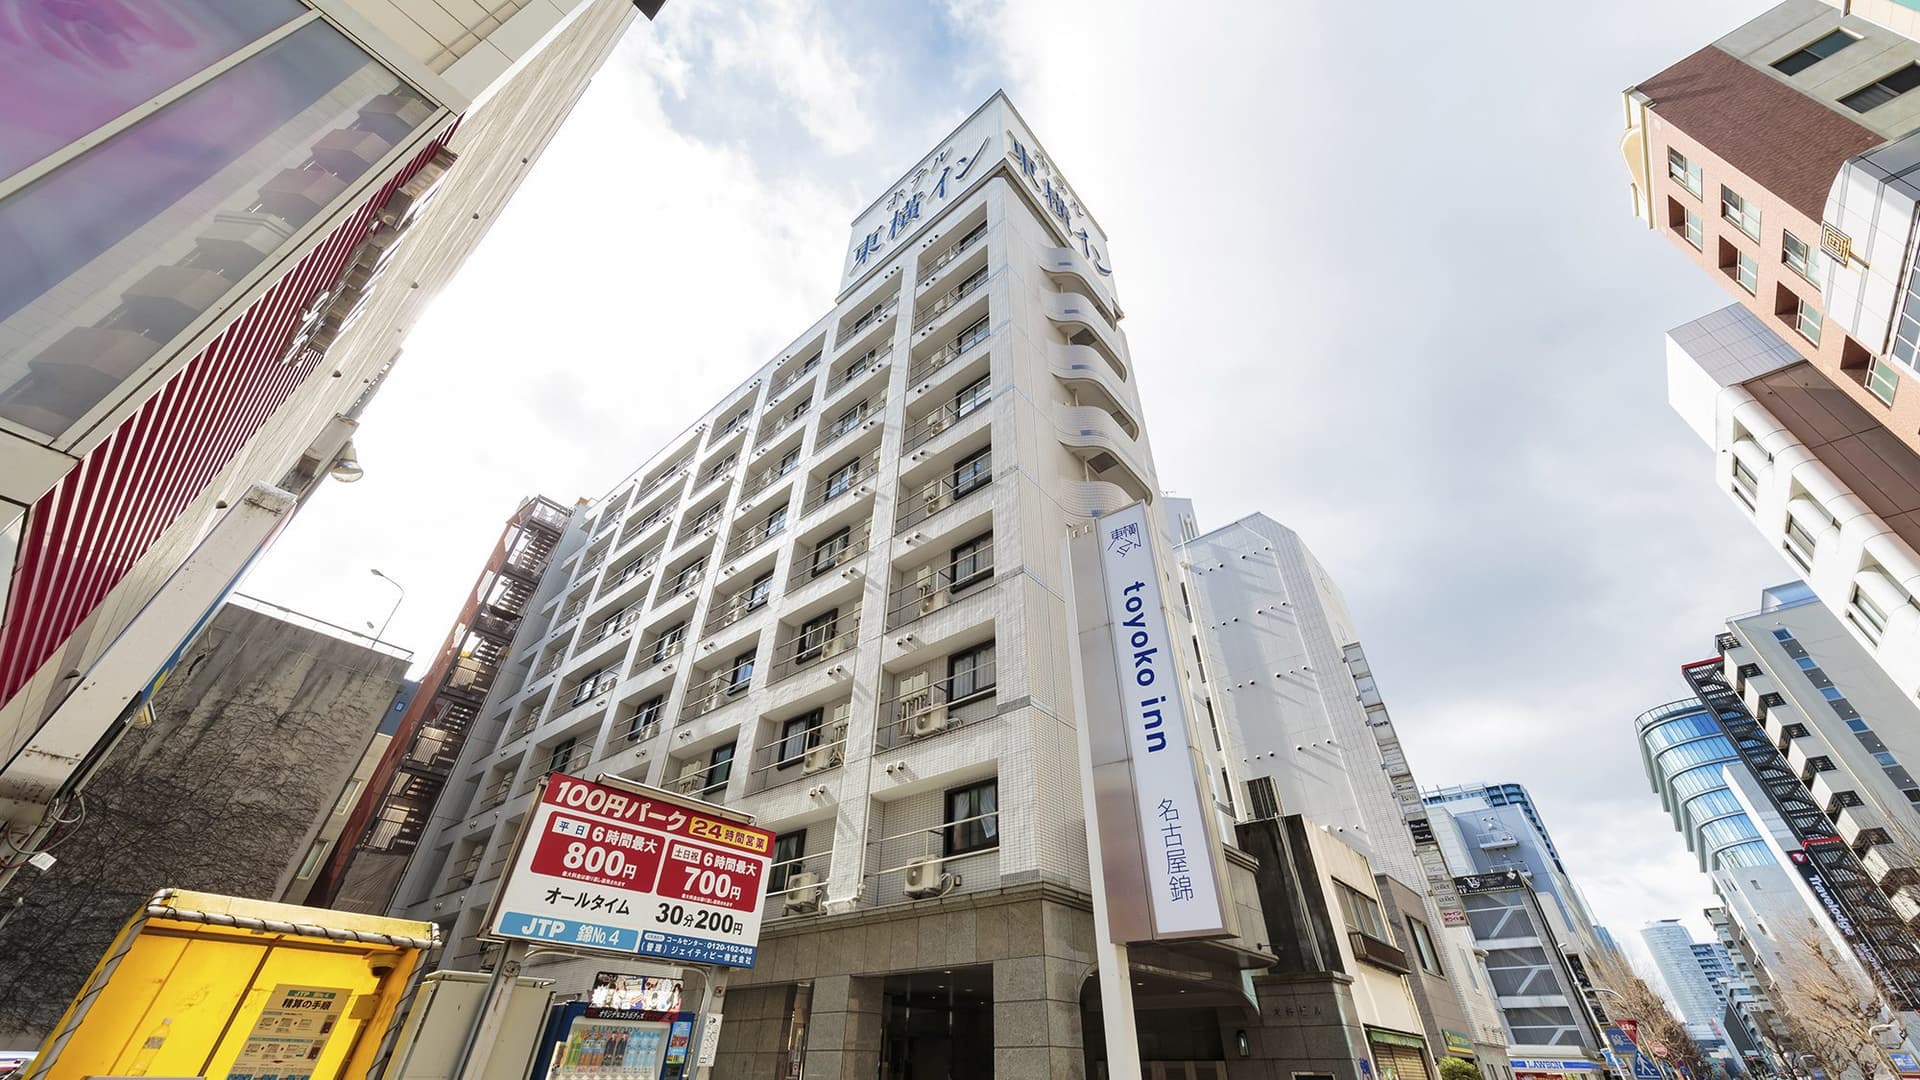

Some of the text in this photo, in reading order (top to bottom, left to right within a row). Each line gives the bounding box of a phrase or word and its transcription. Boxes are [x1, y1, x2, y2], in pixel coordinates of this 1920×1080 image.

[849, 136, 992, 276] 東横イン
[1006, 128, 1113, 277] 東横イン
[1123, 580, 1169, 754] toyoko inn
[555, 780, 688, 832] 100円パーク
[558, 820, 659, 855] 平日 6時間最大
[692, 818, 766, 851] 24時間営業
[1157, 797, 1195, 903] 名古屋錦
[563, 842, 637, 880] 800円
[703, 853, 757, 877] 6時間最大
[684, 866, 742, 900] 700円
[544, 887, 630, 916] オールタイム
[1809, 874, 1855, 936] Travelodge
[521, 917, 566, 939] JTP
[282, 998, 333, 1010] 精算の手順
